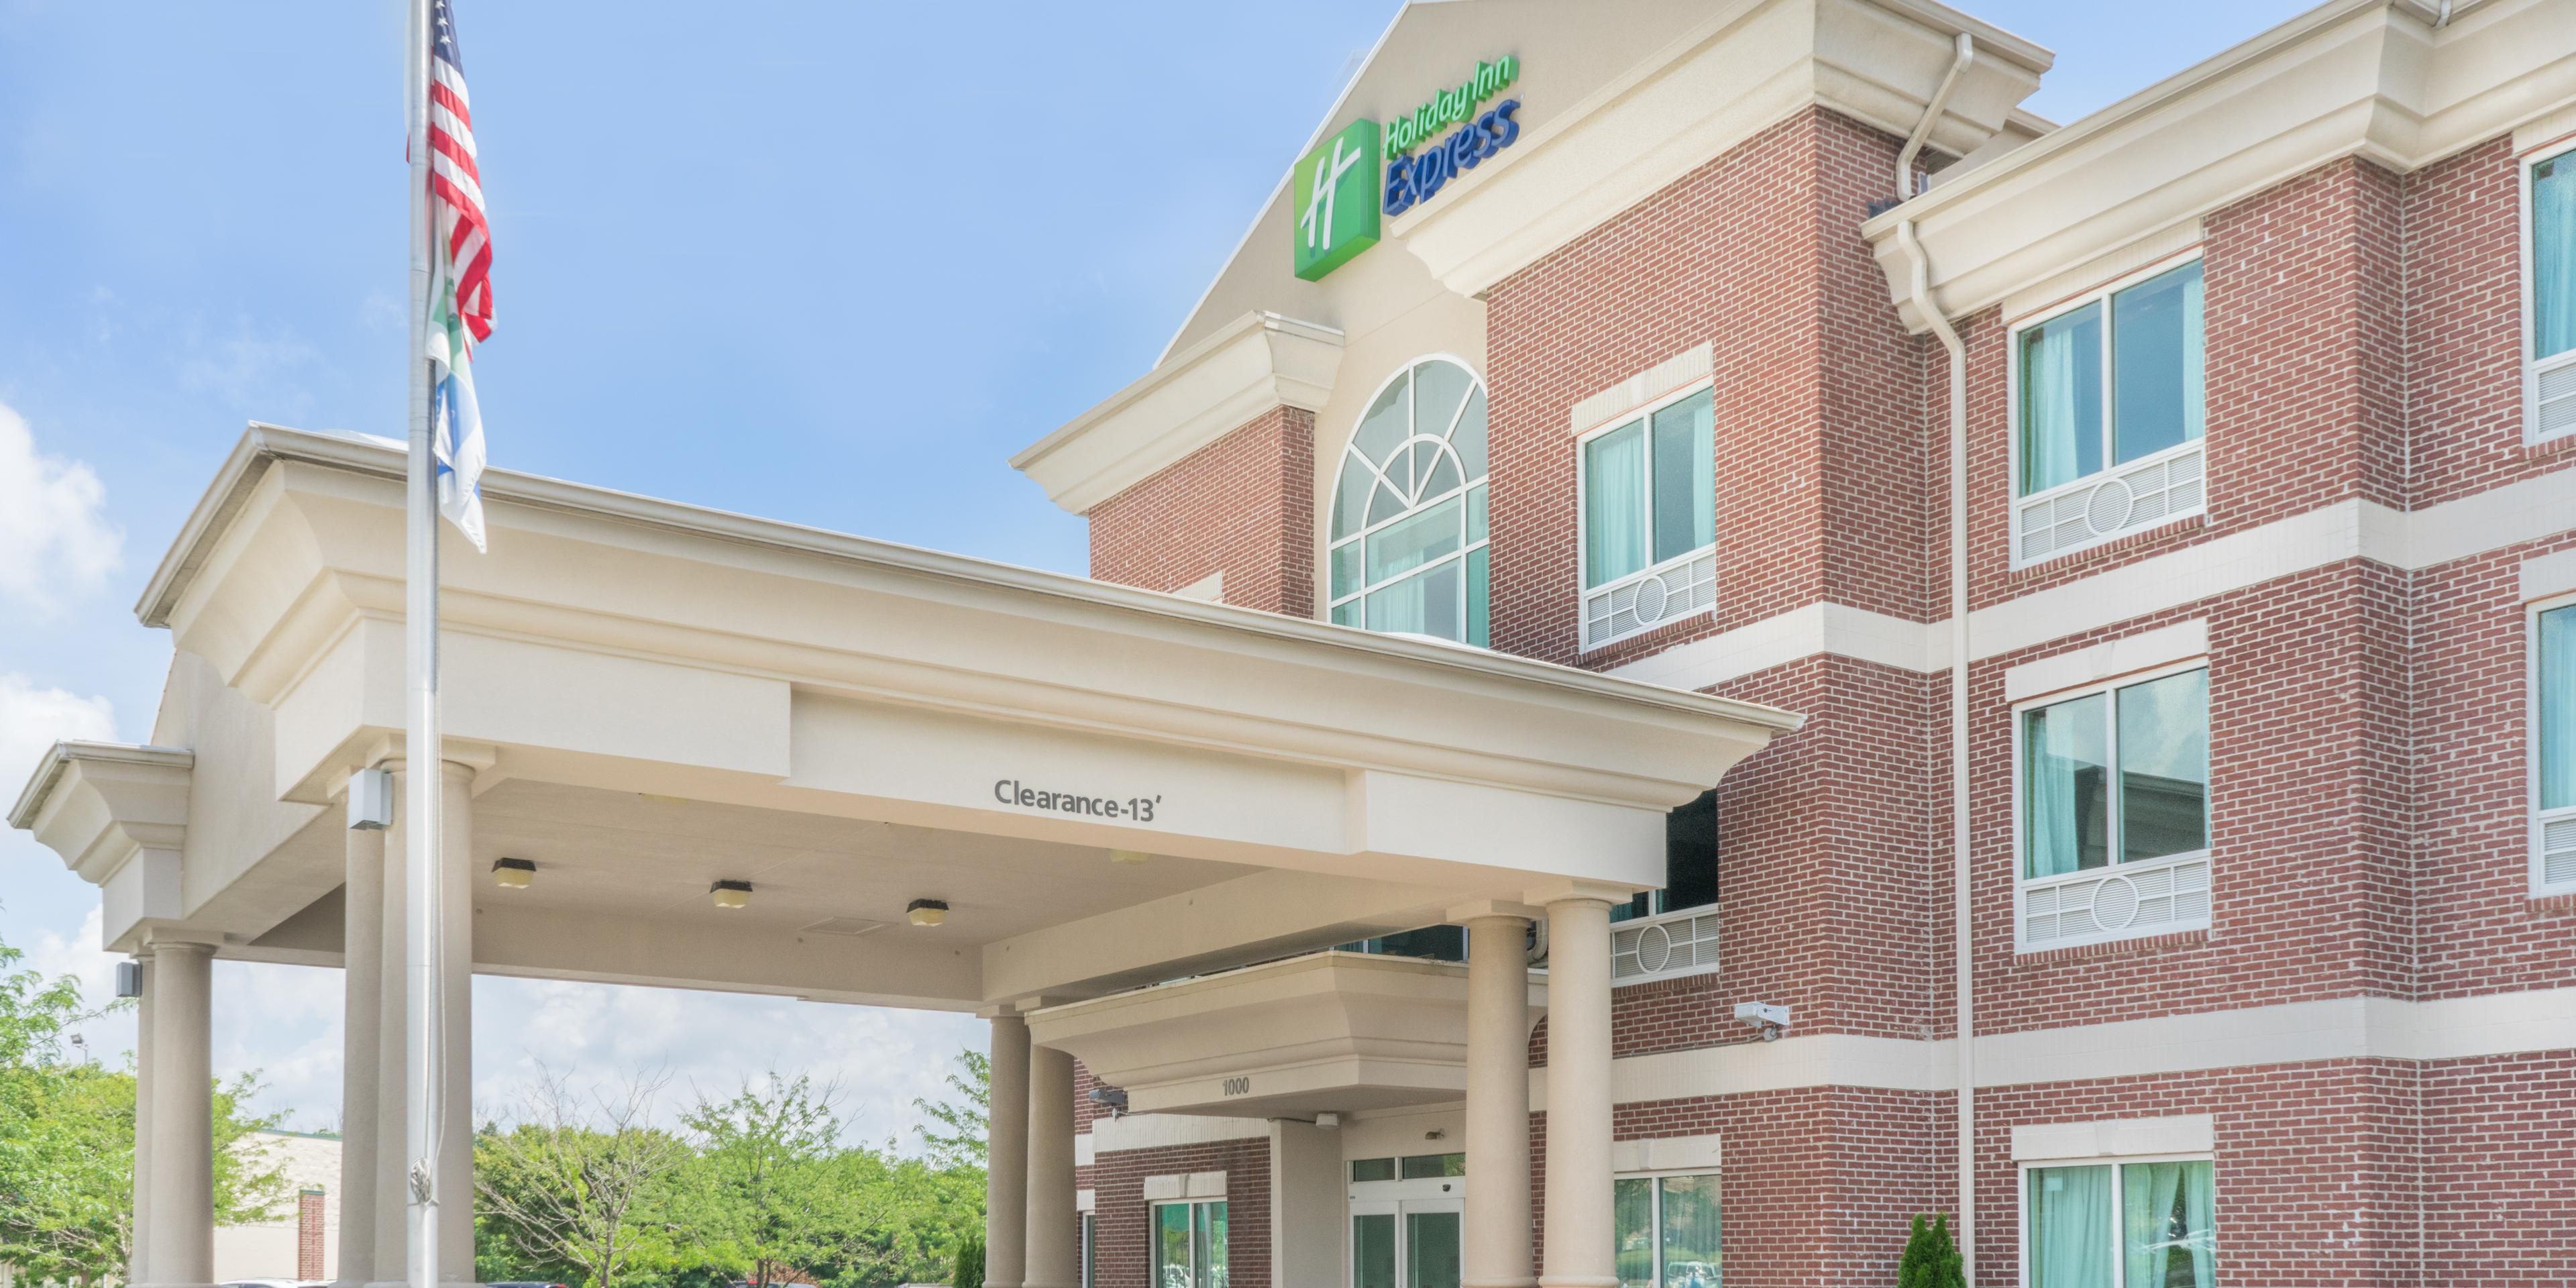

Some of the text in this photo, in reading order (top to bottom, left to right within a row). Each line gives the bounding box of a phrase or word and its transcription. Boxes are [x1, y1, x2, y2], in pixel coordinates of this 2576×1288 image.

[1383, 55, 1519, 160] Holiday Inn
[1383, 99, 1521, 216] Express
[994, 780, 1162, 822] Clearance-13'
[1223, 1077, 1249, 1096] 1000
